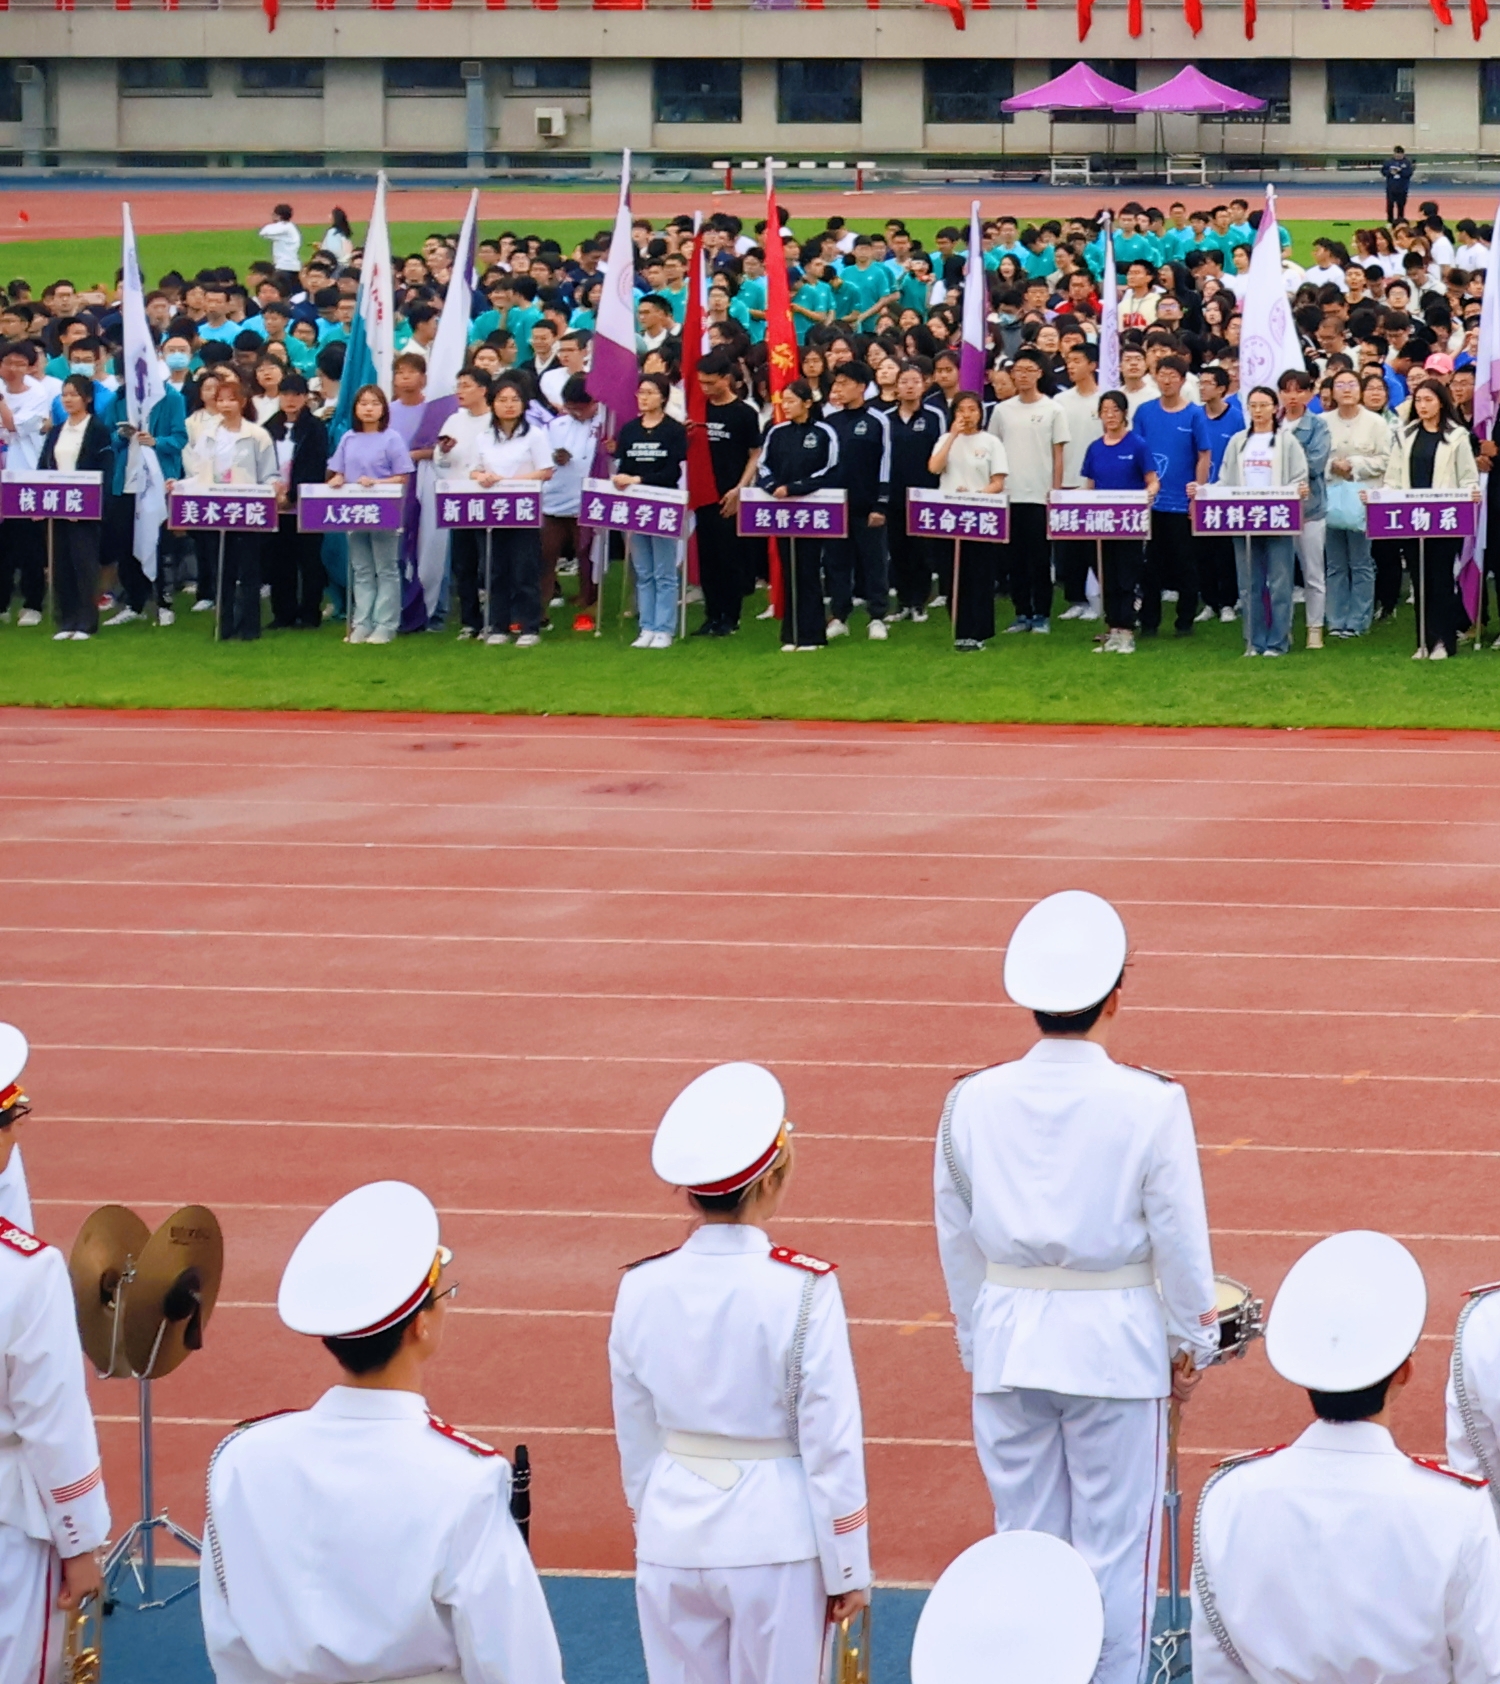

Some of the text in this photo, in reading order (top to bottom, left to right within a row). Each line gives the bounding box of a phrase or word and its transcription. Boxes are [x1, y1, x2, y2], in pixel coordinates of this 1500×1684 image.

[20, 488, 83, 512] 核研院
[443, 498, 535, 522] 新闻学院
[181, 501, 266, 525] 美术学院
[323, 504, 381, 524] 人文学院
[587, 498, 679, 533] 金融学院
[755, 508, 831, 530] 经管学院
[919, 507, 998, 535] 生命学院
[1203, 504, 1291, 529] 材料学院
[1384, 506, 1458, 531] 工物系
